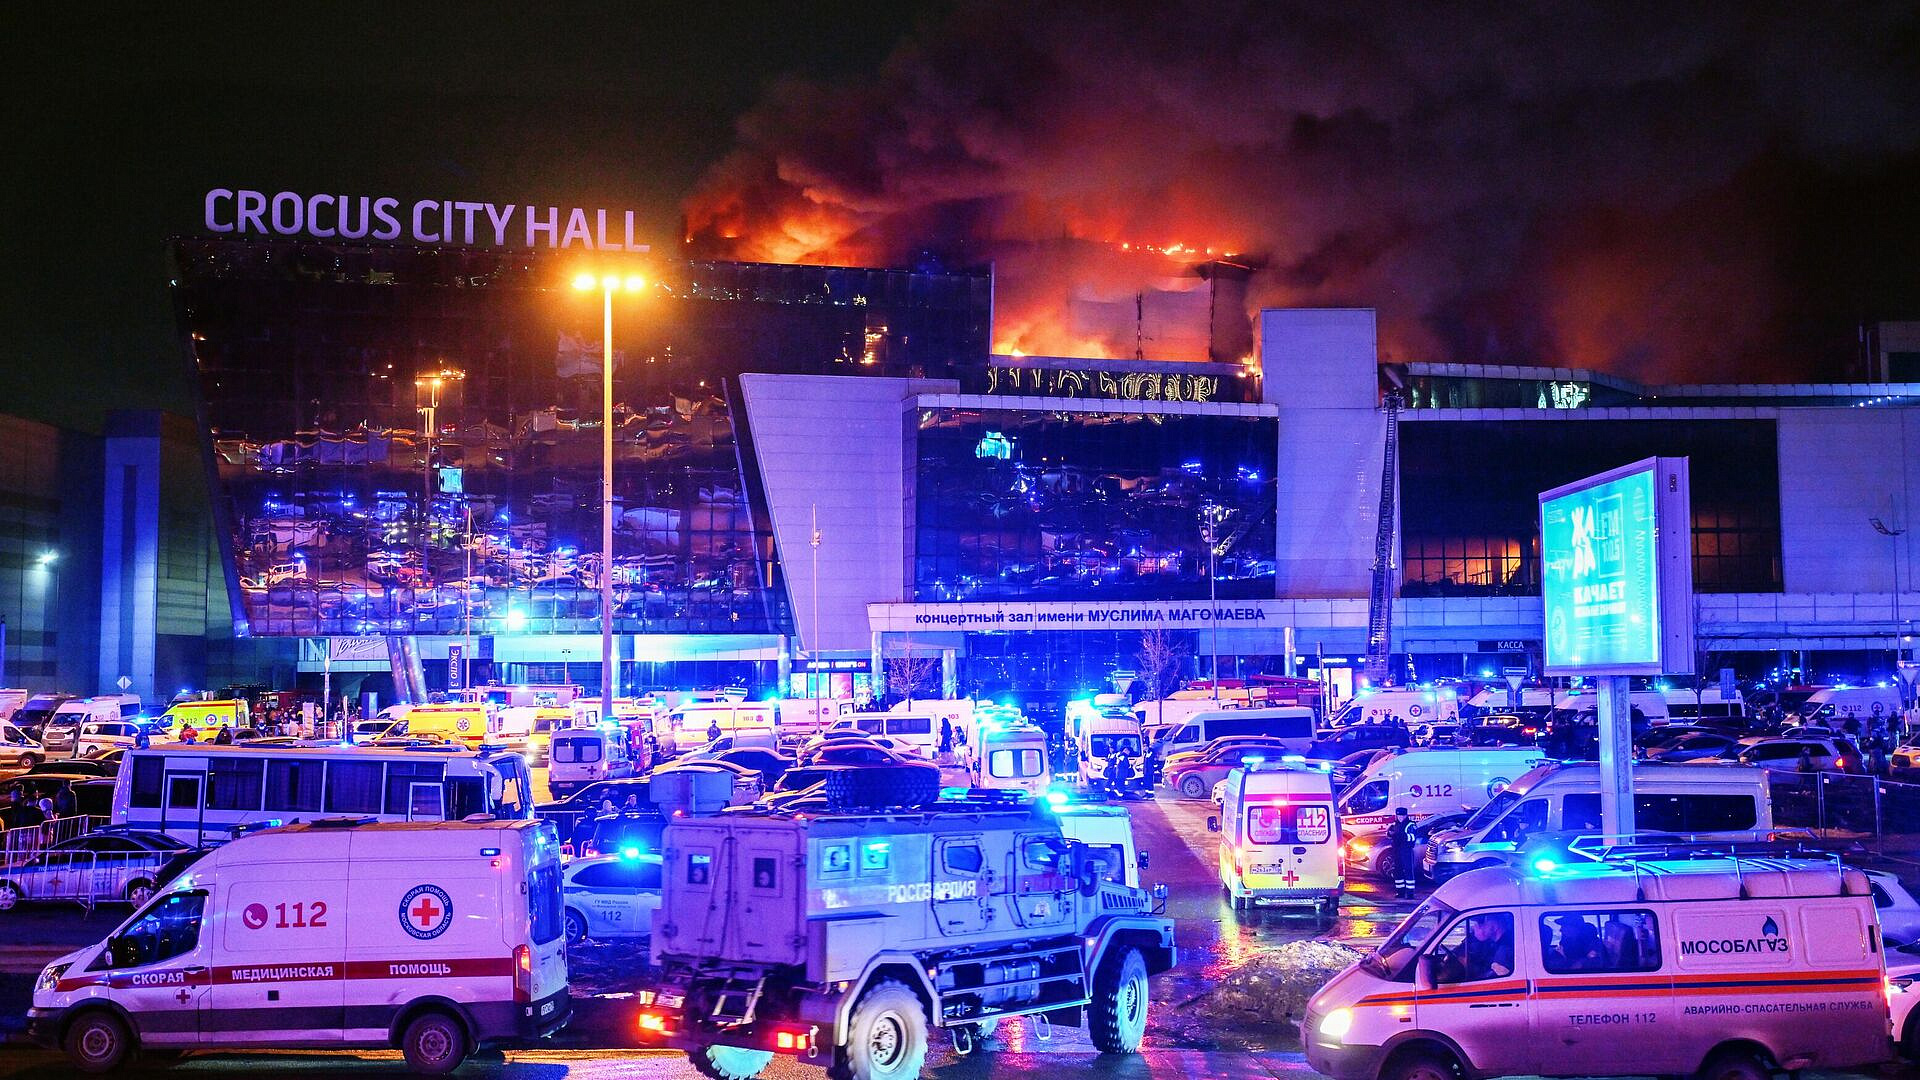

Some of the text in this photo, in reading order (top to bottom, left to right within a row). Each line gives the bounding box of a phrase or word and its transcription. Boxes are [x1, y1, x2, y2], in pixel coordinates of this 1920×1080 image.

[205, 188, 650, 252] CROCUS CITY HALL
[1573, 581, 1626, 605] КАЧАЕТ
[915, 608, 1266, 626] концертный зал имени МУСЛИМА МАГОМАЕВА
[1497, 641, 1525, 649] КАССА
[1425, 784, 1453, 797] 112
[1298, 813, 1326, 828] 112
[1355, 816, 1383, 824] СКОРАЯ
[1297, 829, 1327, 837] СПАСЕНИЯ
[402, 885, 450, 908] СКОРАЯ ПОМОЩЬ
[888, 880, 977, 903] РОСГВАРДИЯ
[275, 901, 327, 928] 112
[601, 910, 622, 921] 112
[401, 911, 452, 938] МОСКОВСКАЯ ОБЛАСТЬ
[132, 963, 451, 985] СКОРАЯ МЕДИЦИНСКАЯ ПОМОЩЬ
[1684, 1000, 1873, 1015] АВАРИЙНО-СПАСАТЕЛЬНАЯ СЛУЖБА
[1568, 1012, 1657, 1025] ТЕЛЕФОН 112
